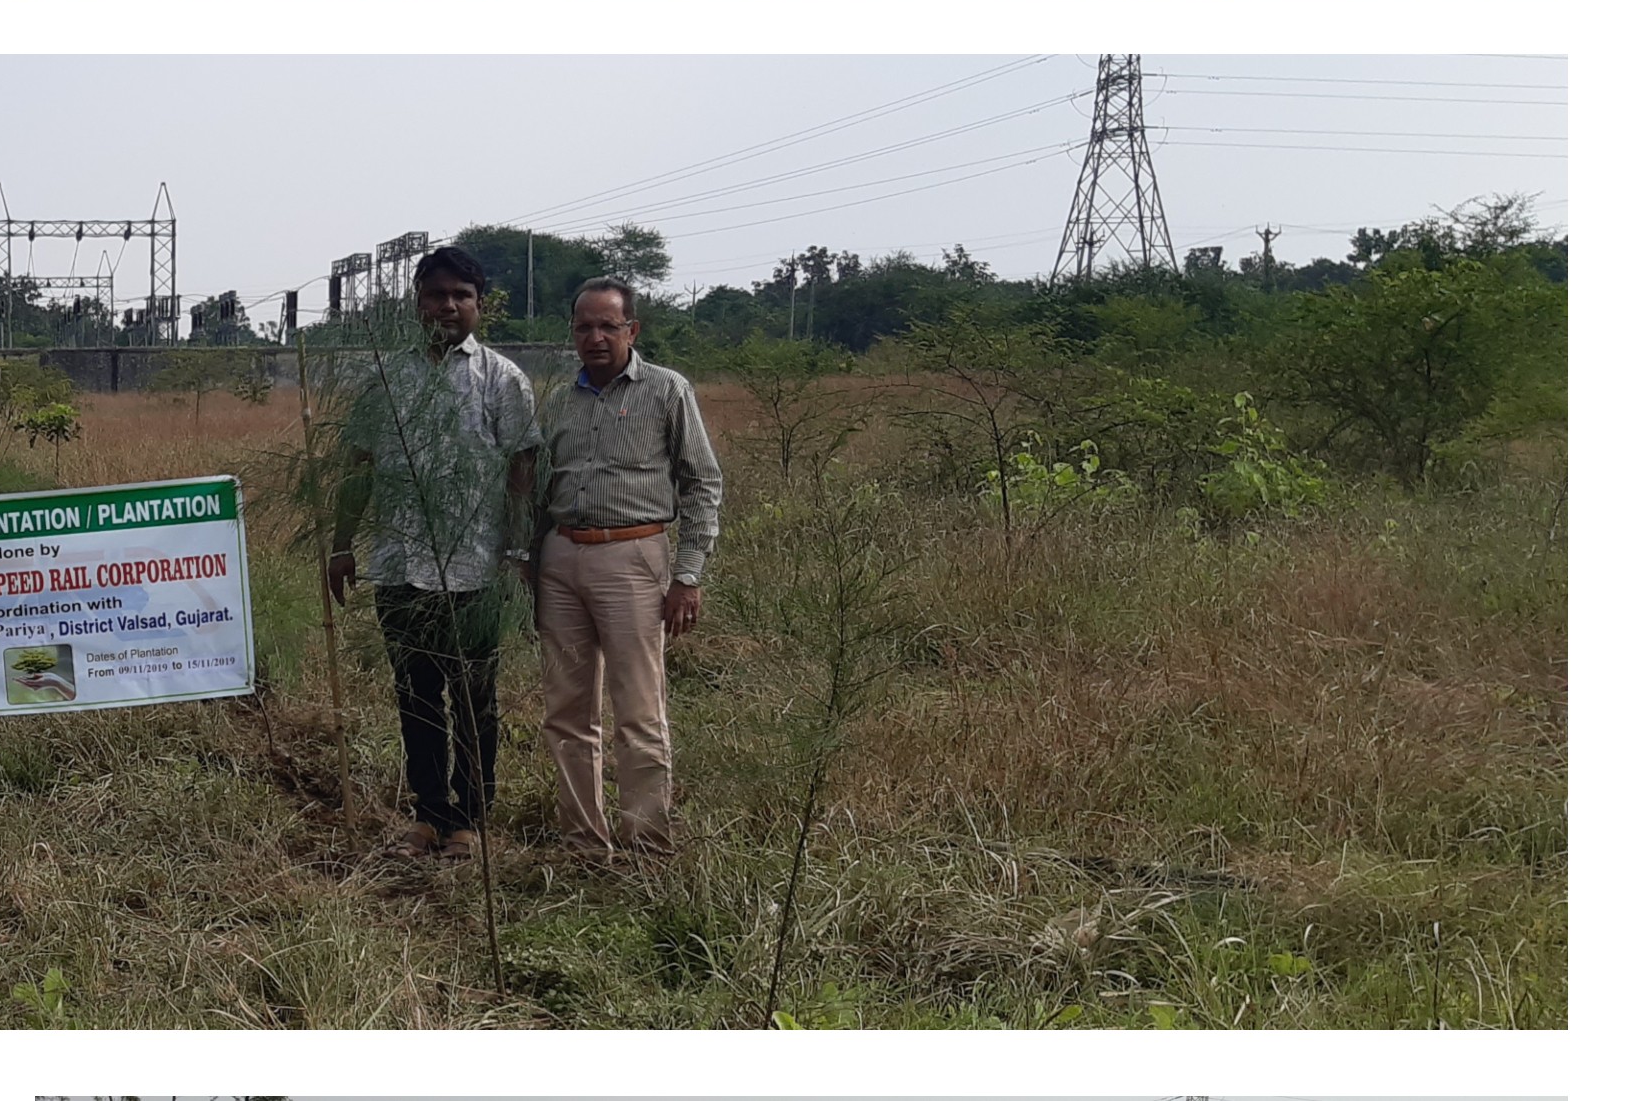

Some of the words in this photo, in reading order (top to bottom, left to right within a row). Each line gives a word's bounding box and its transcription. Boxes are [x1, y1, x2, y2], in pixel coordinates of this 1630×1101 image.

[97, 494, 221, 525] PLANTATION
[40, 544, 60, 558] by
[49, 566, 92, 592] RAIL
[97, 553, 227, 588] CORPORATION
[87, 596, 123, 611] with
[59, 618, 113, 636] District
[117, 612, 171, 631] Valsad,
[176, 606, 233, 629] Gujarat.
[86, 652, 115, 663] Dates
[118, 650, 128, 661] of
[131, 647, 179, 659] Plantation
[88, 667, 115, 678] From
[172, 661, 183, 671] to
